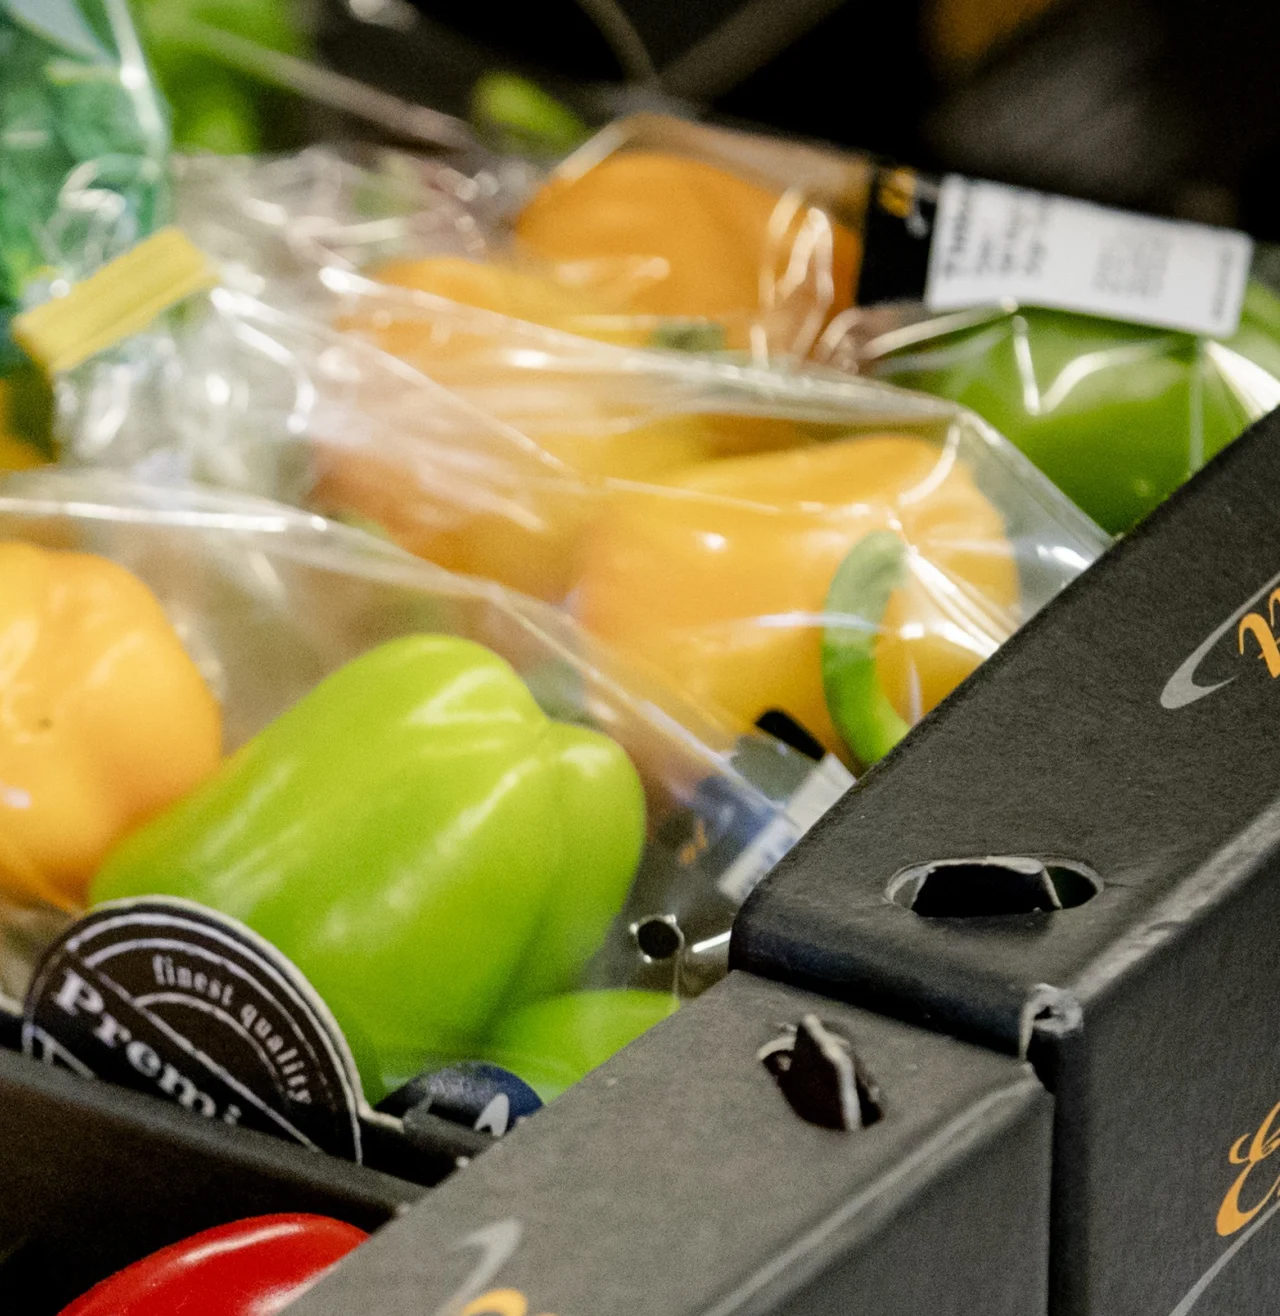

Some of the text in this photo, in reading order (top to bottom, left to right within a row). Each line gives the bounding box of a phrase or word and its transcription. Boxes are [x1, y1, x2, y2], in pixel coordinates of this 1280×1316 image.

[54, 968, 242, 1125] Prem
[151, 953, 313, 1104] finest quality
